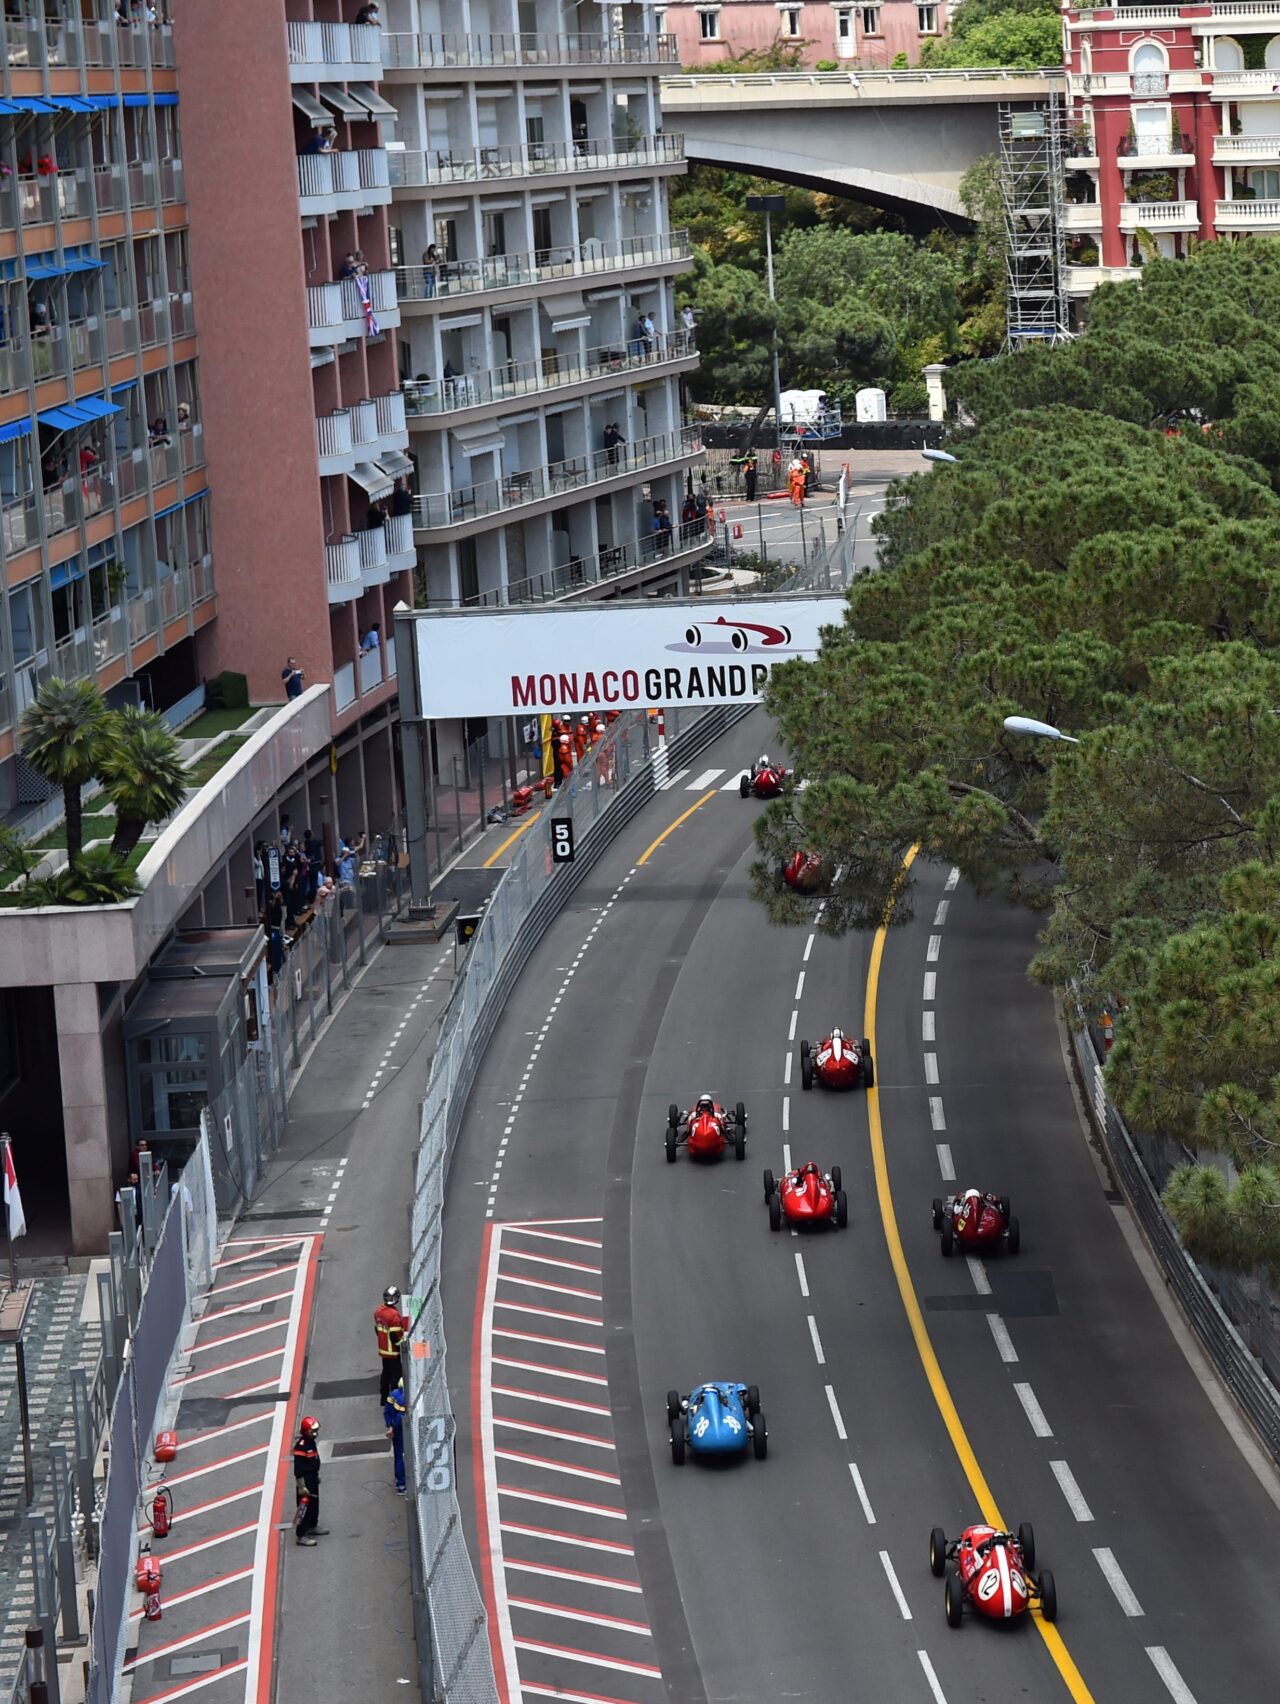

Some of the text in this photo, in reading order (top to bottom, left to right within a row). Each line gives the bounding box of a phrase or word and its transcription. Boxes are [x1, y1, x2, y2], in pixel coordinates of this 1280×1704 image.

[511, 669, 640, 707] MONACO
[644, 664, 747, 701] GRAND
[555, 824, 570, 857] 50
[426, 1417, 451, 1491] 100
[981, 1572, 999, 1596] 12
